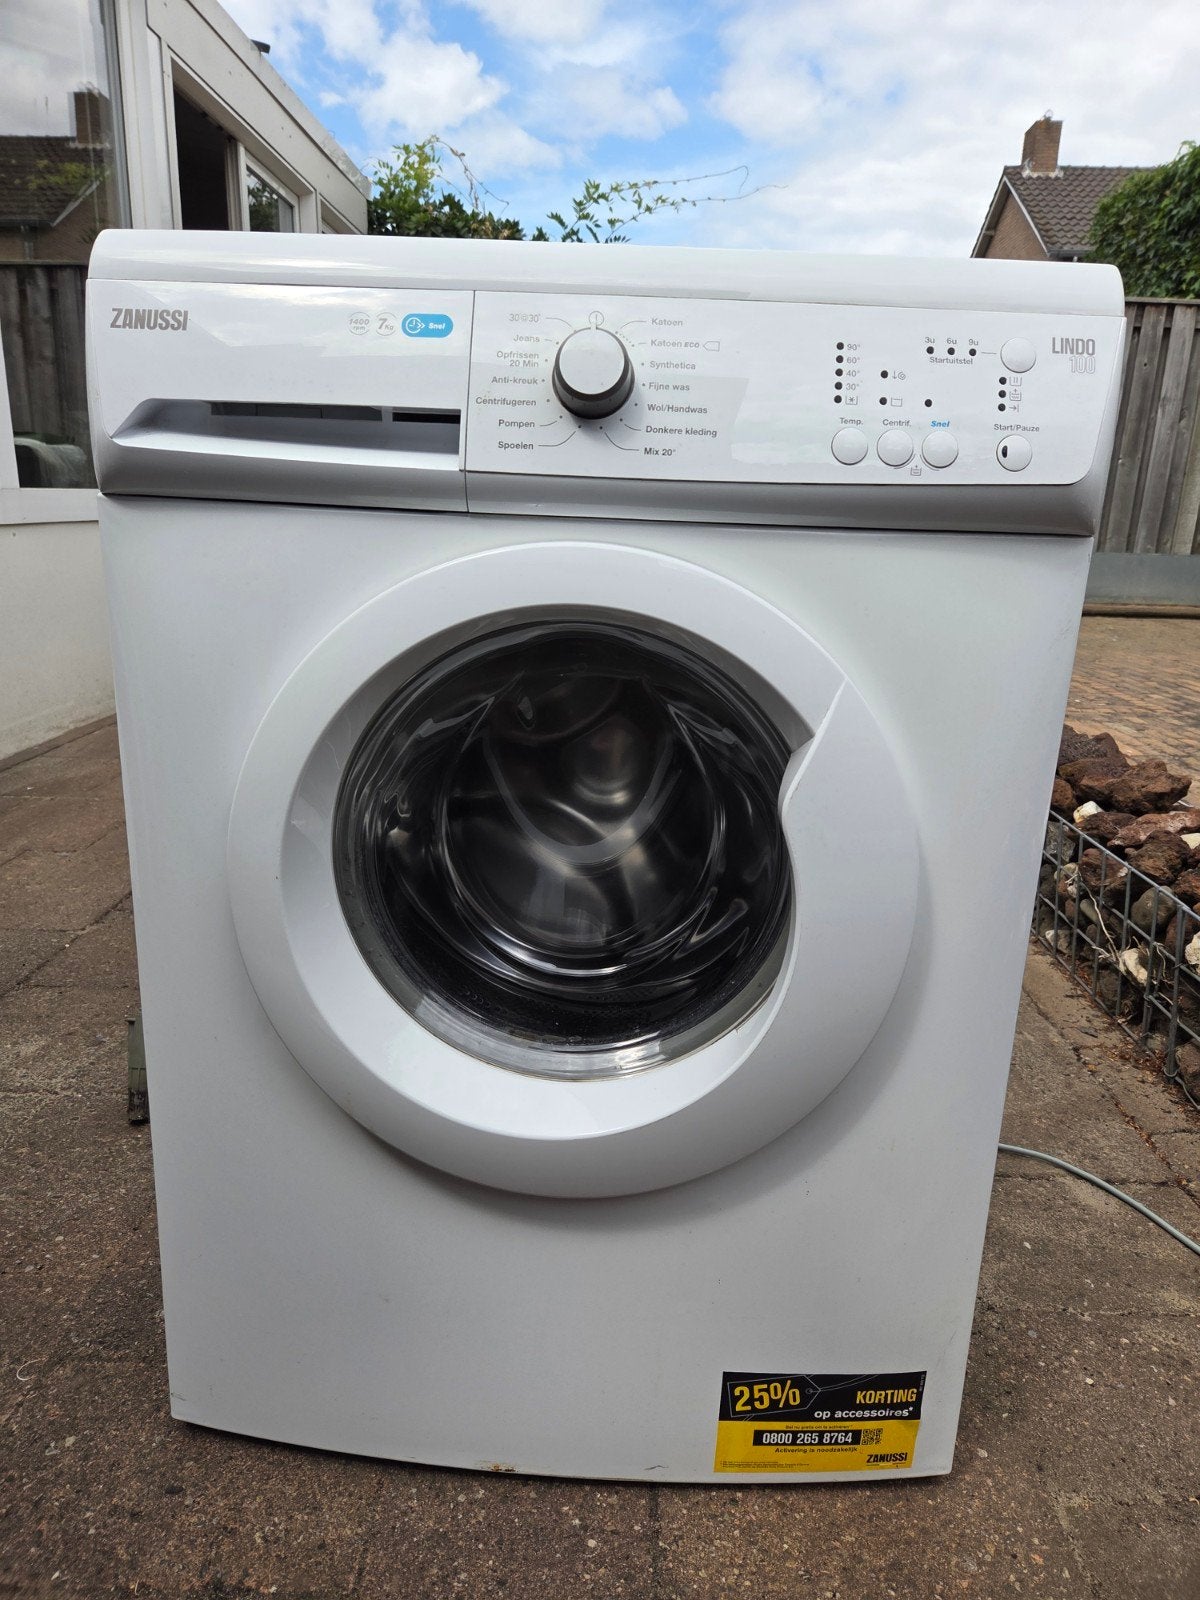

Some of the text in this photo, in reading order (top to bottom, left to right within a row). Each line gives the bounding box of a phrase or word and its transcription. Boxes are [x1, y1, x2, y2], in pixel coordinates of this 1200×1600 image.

[110, 308, 188, 331] ZANUSSI
[652, 318, 683, 326] Katoen
[513, 334, 540, 343] Jeans
[650, 339, 682, 348] Katoen
[924, 336, 936, 345] 3u
[946, 337, 957, 345] 6u
[1051, 337, 1096, 356] LINDO
[496, 351, 539, 360] Opfrissen
[929, 356, 974, 365] Startuitstel
[509, 359, 539, 368] 20 Min
[650, 360, 696, 371] Synthetica
[1069, 356, 1095, 374] 100
[491, 376, 538, 385] Anti-kreuk
[648, 383, 670, 393] Fijne
[475, 396, 537, 407] Centrifugeren
[647, 404, 708, 414] Wol/Handwas
[498, 419, 535, 429] Pompen
[839, 417, 864, 426] Temp.
[882, 419, 911, 427] Centrif.
[646, 426, 718, 437] Donkere kleding
[993, 423, 1040, 433] Start/Pauze
[498, 441, 534, 451] Spoelen
[643, 447, 660, 456] Mix
[734, 1380, 800, 1412] 25%
[856, 1388, 917, 1404] KORTING
[814, 1410, 832, 1420] op
[762, 1432, 853, 1444] 0800 265 8764
[866, 1452, 908, 1463] ZANUSSI
